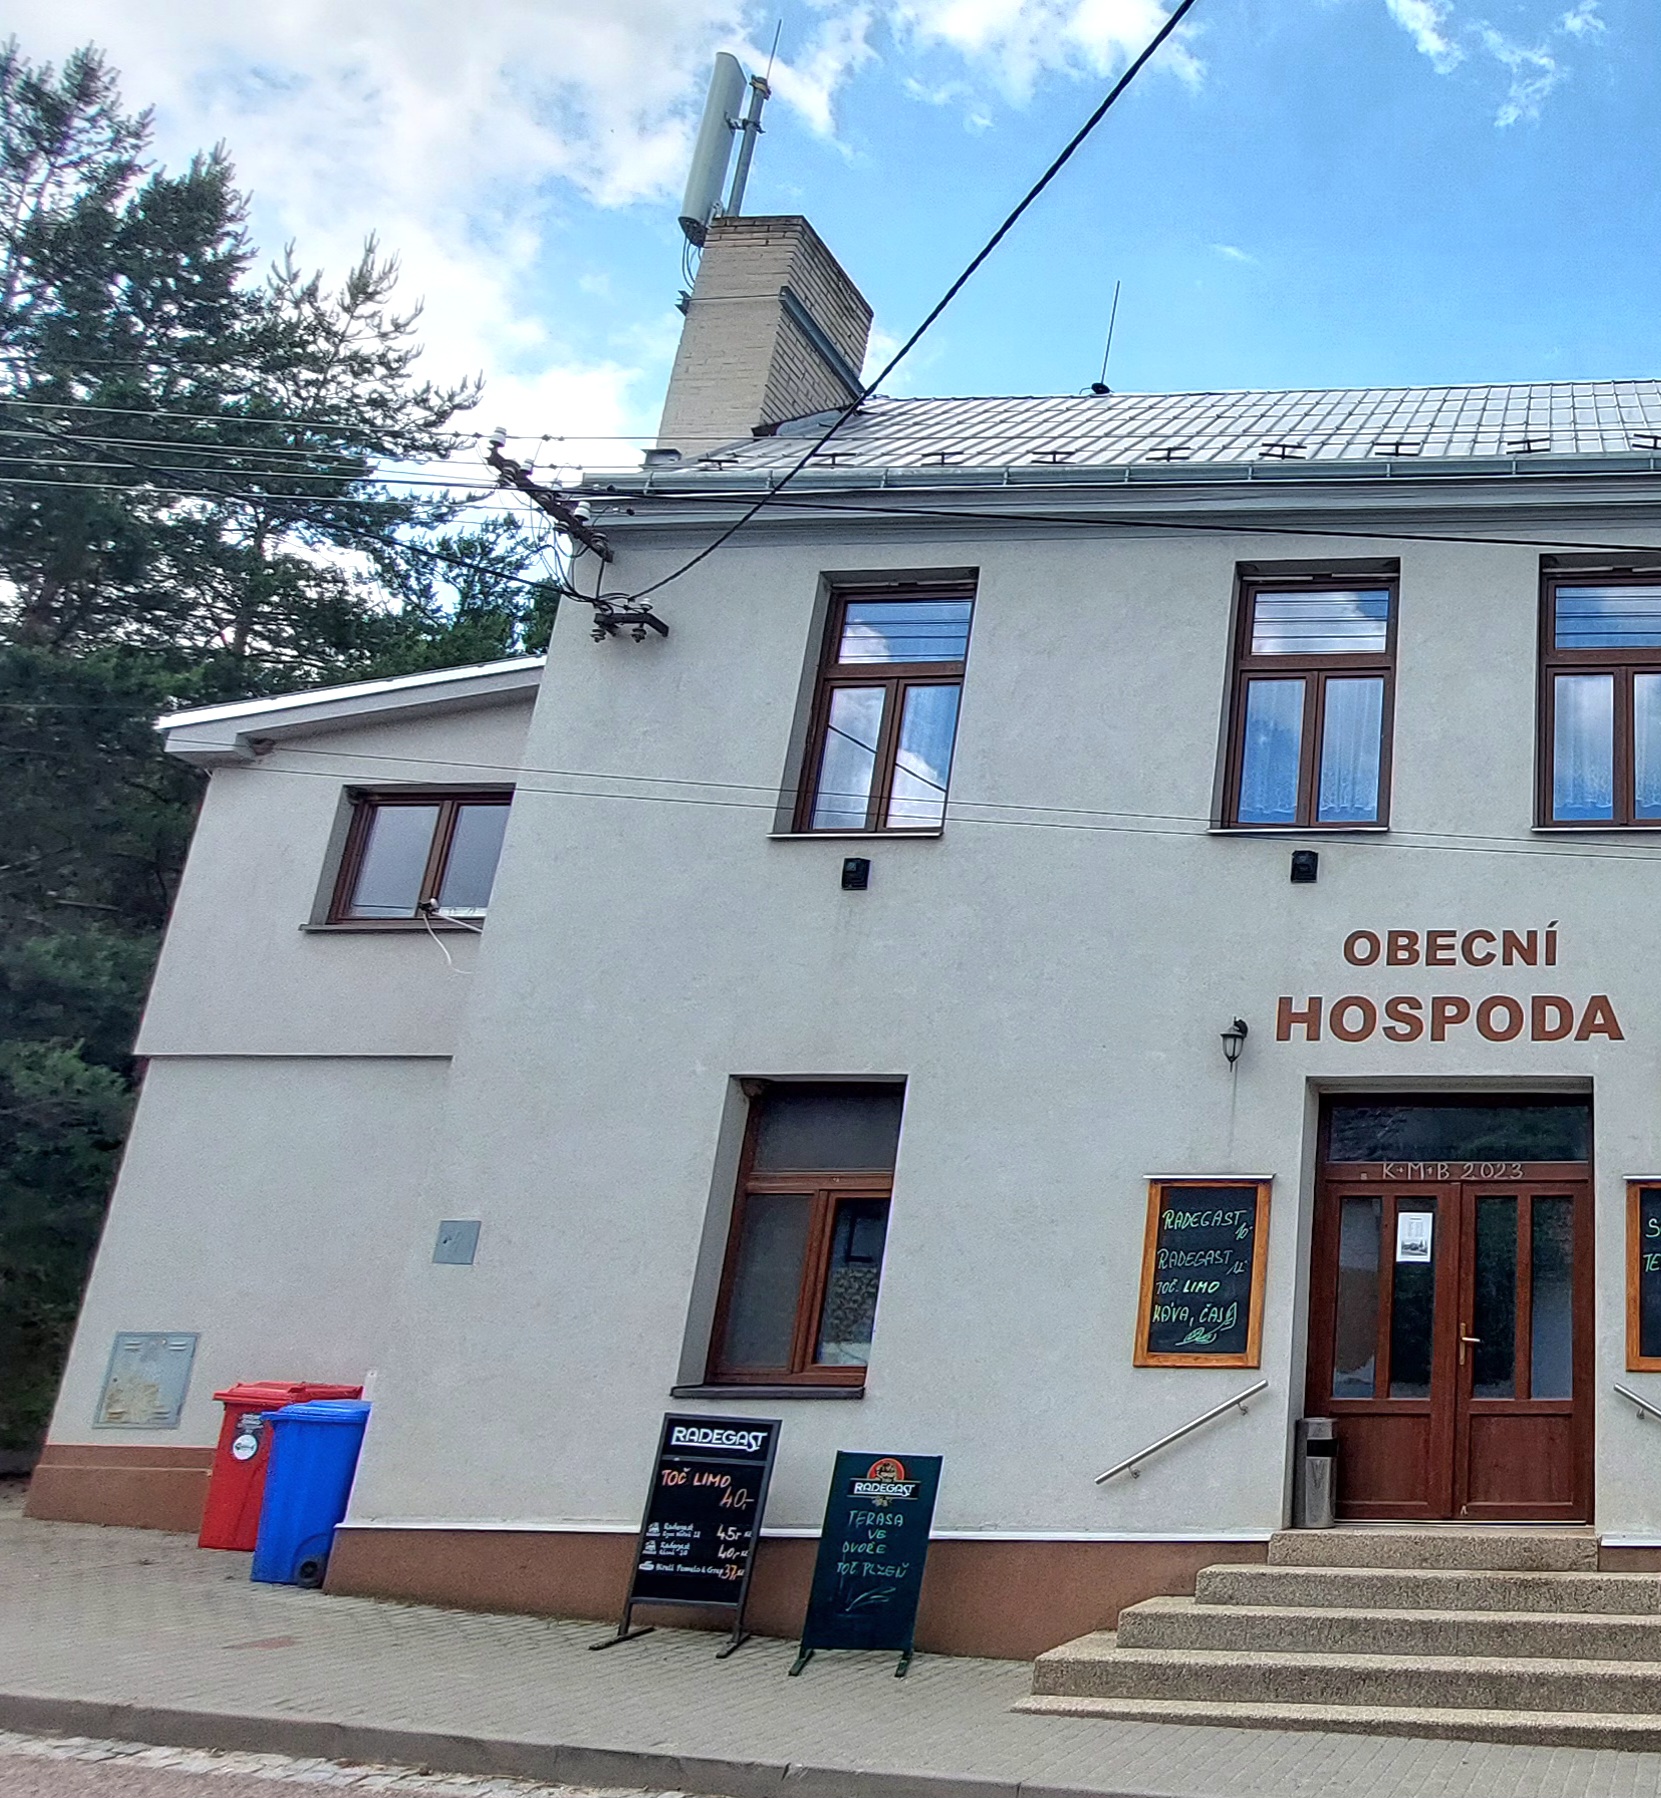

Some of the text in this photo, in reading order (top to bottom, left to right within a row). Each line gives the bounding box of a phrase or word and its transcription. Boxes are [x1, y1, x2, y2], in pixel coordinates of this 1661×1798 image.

[1343, 919, 1559, 967] OBECNÍ
[1275, 994, 1626, 1043] HOSPODA
[1460, 1162, 1524, 1180] 2023
[1162, 1209, 1248, 1230] RADEGAST
[1156, 1248, 1233, 1270] RADEGAST
[1182, 1280, 1221, 1294] LIMO
[671, 1426, 769, 1452] RADEGAST
[661, 1467, 732, 1488] TOČ LIMO
[853, 1482, 916, 1497] RADEGAST
[848, 1510, 904, 1528] TERASA
[868, 1529, 887, 1540] VE
